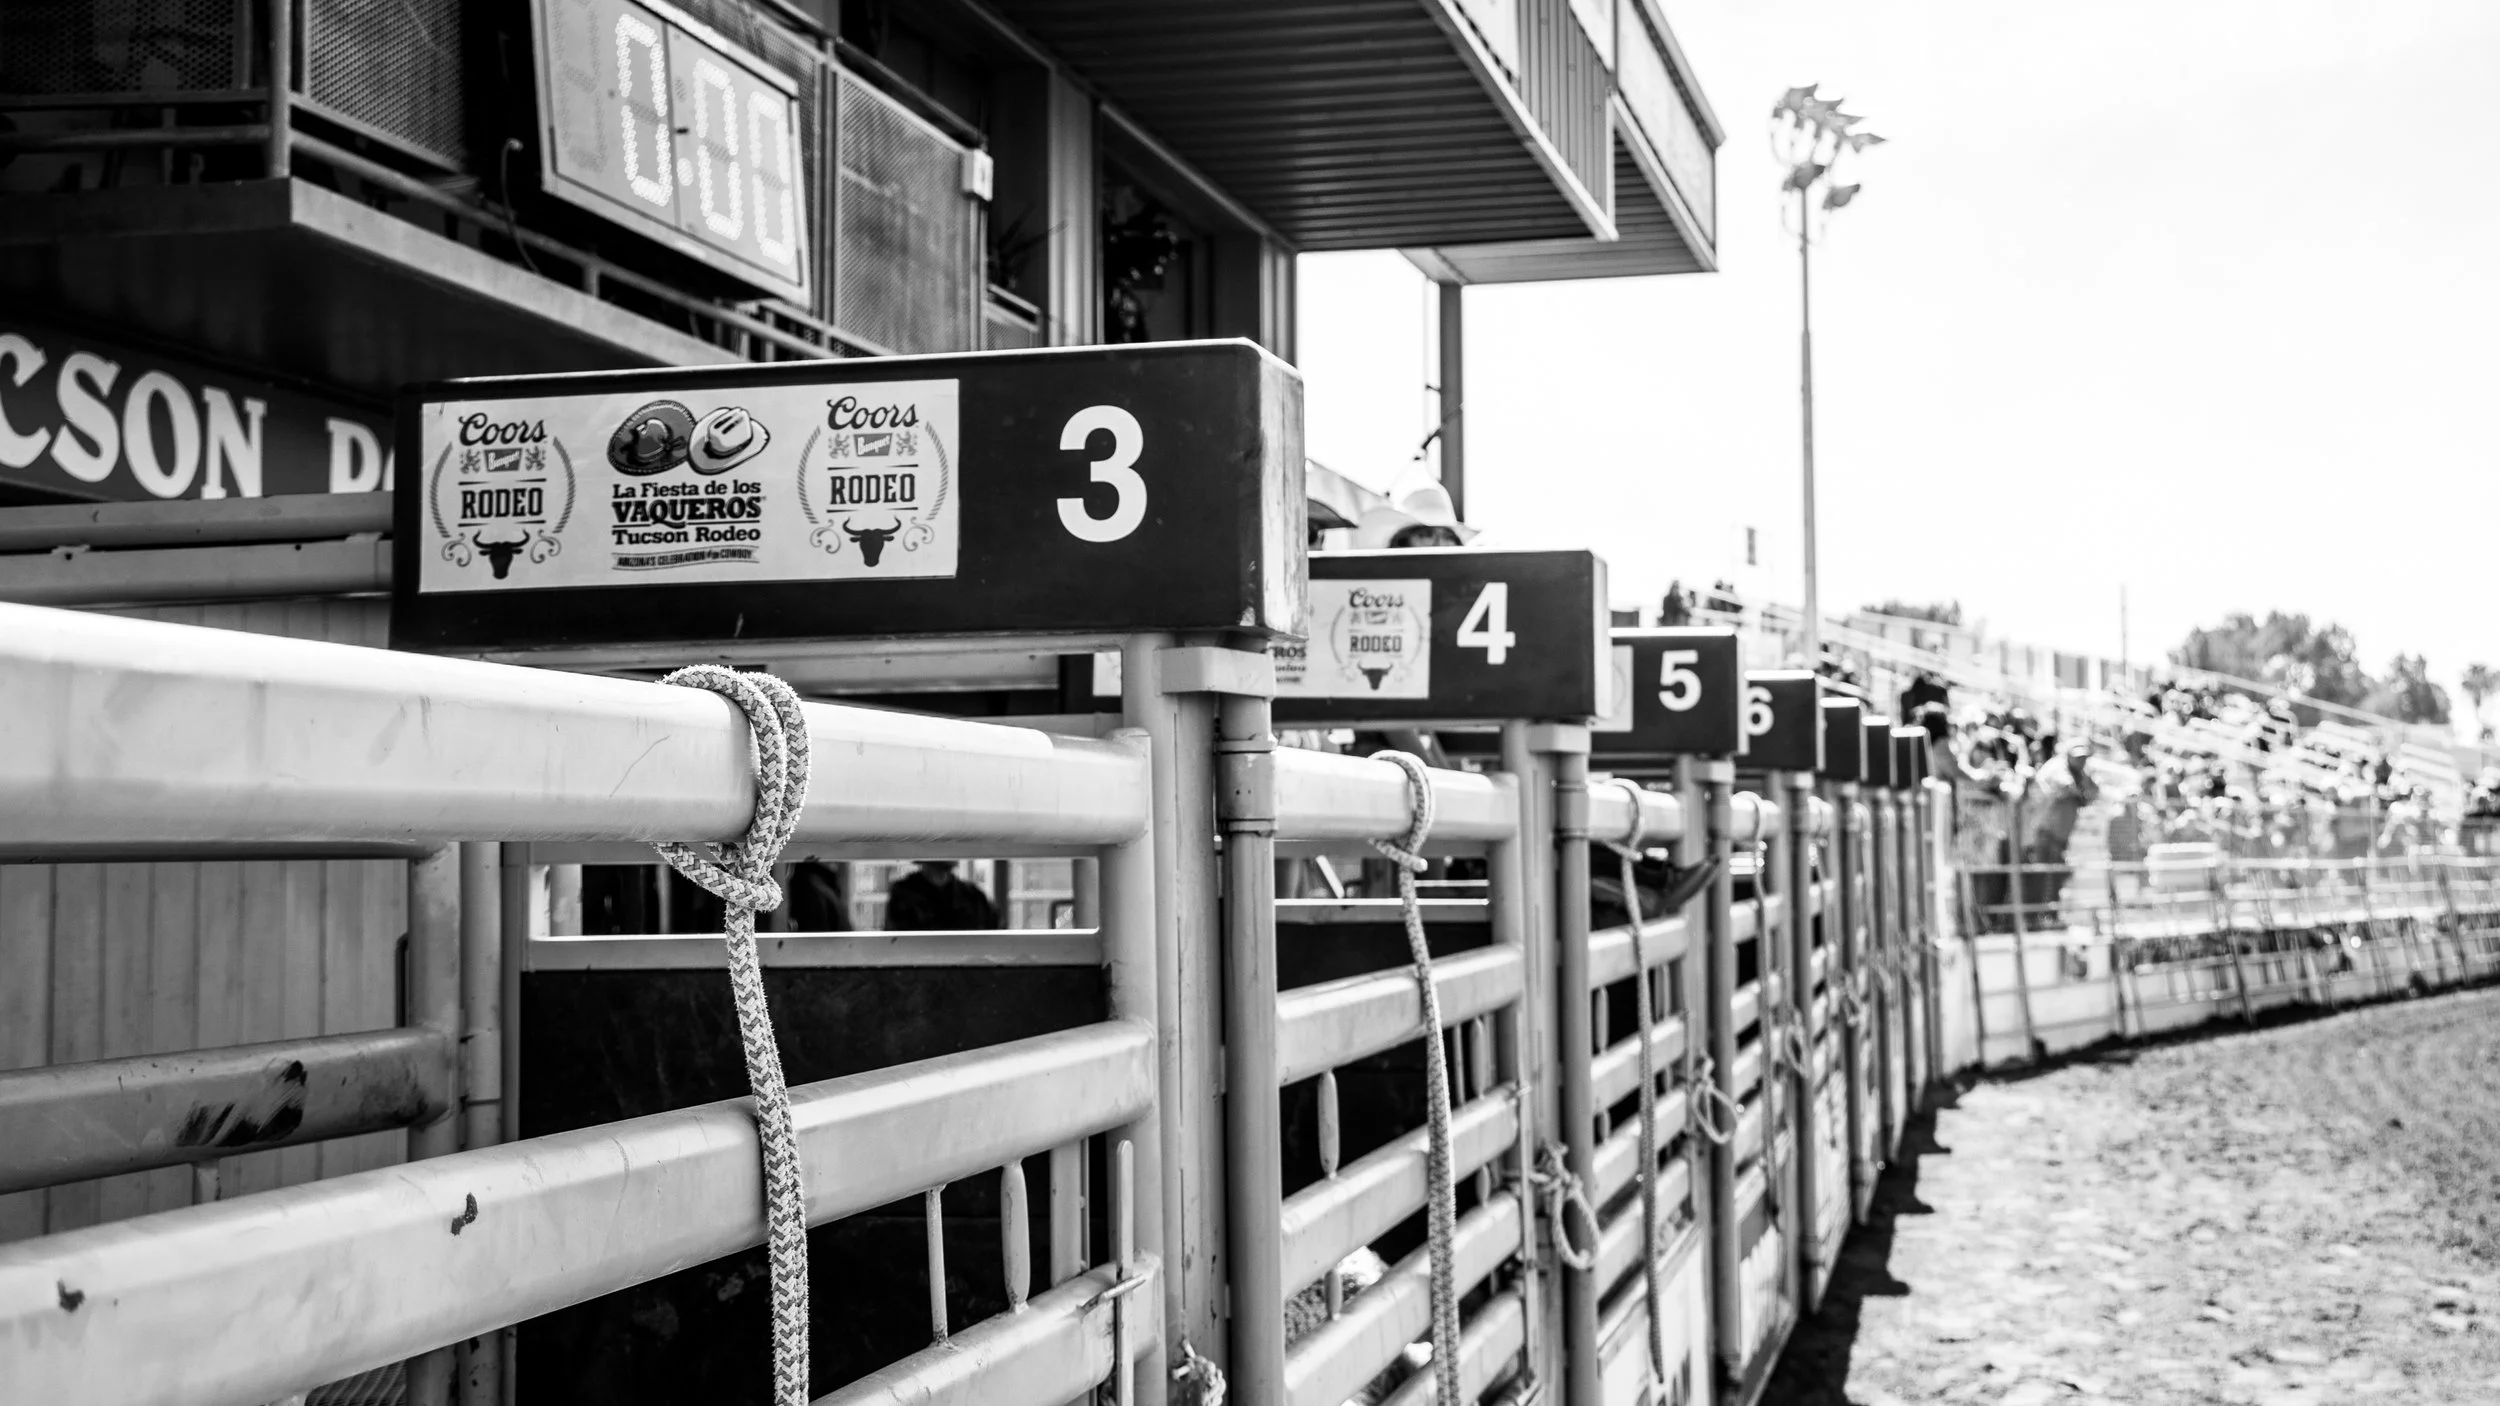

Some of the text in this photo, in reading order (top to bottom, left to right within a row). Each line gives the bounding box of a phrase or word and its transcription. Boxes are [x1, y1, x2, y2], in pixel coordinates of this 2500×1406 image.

[458, 412, 547, 446] Coors
[827, 396, 919, 430] Coors
[326, 416, 394, 494] D
[612, 479, 761, 499] La Fiesta de los
[830, 473, 915, 504] RODEO
[1057, 405, 1147, 542] 3
[461, 487, 543, 519] RODEO
[612, 496, 762, 529] VAQUEROS
[612, 525, 761, 545] Tucson Rodeo
[1348, 587, 1404, 608] Coors
[1456, 582, 1516, 665] 4
[1350, 635, 1402, 652] RODEO
[1658, 649, 1702, 712] 5
[1747, 685, 1775, 736] 6
